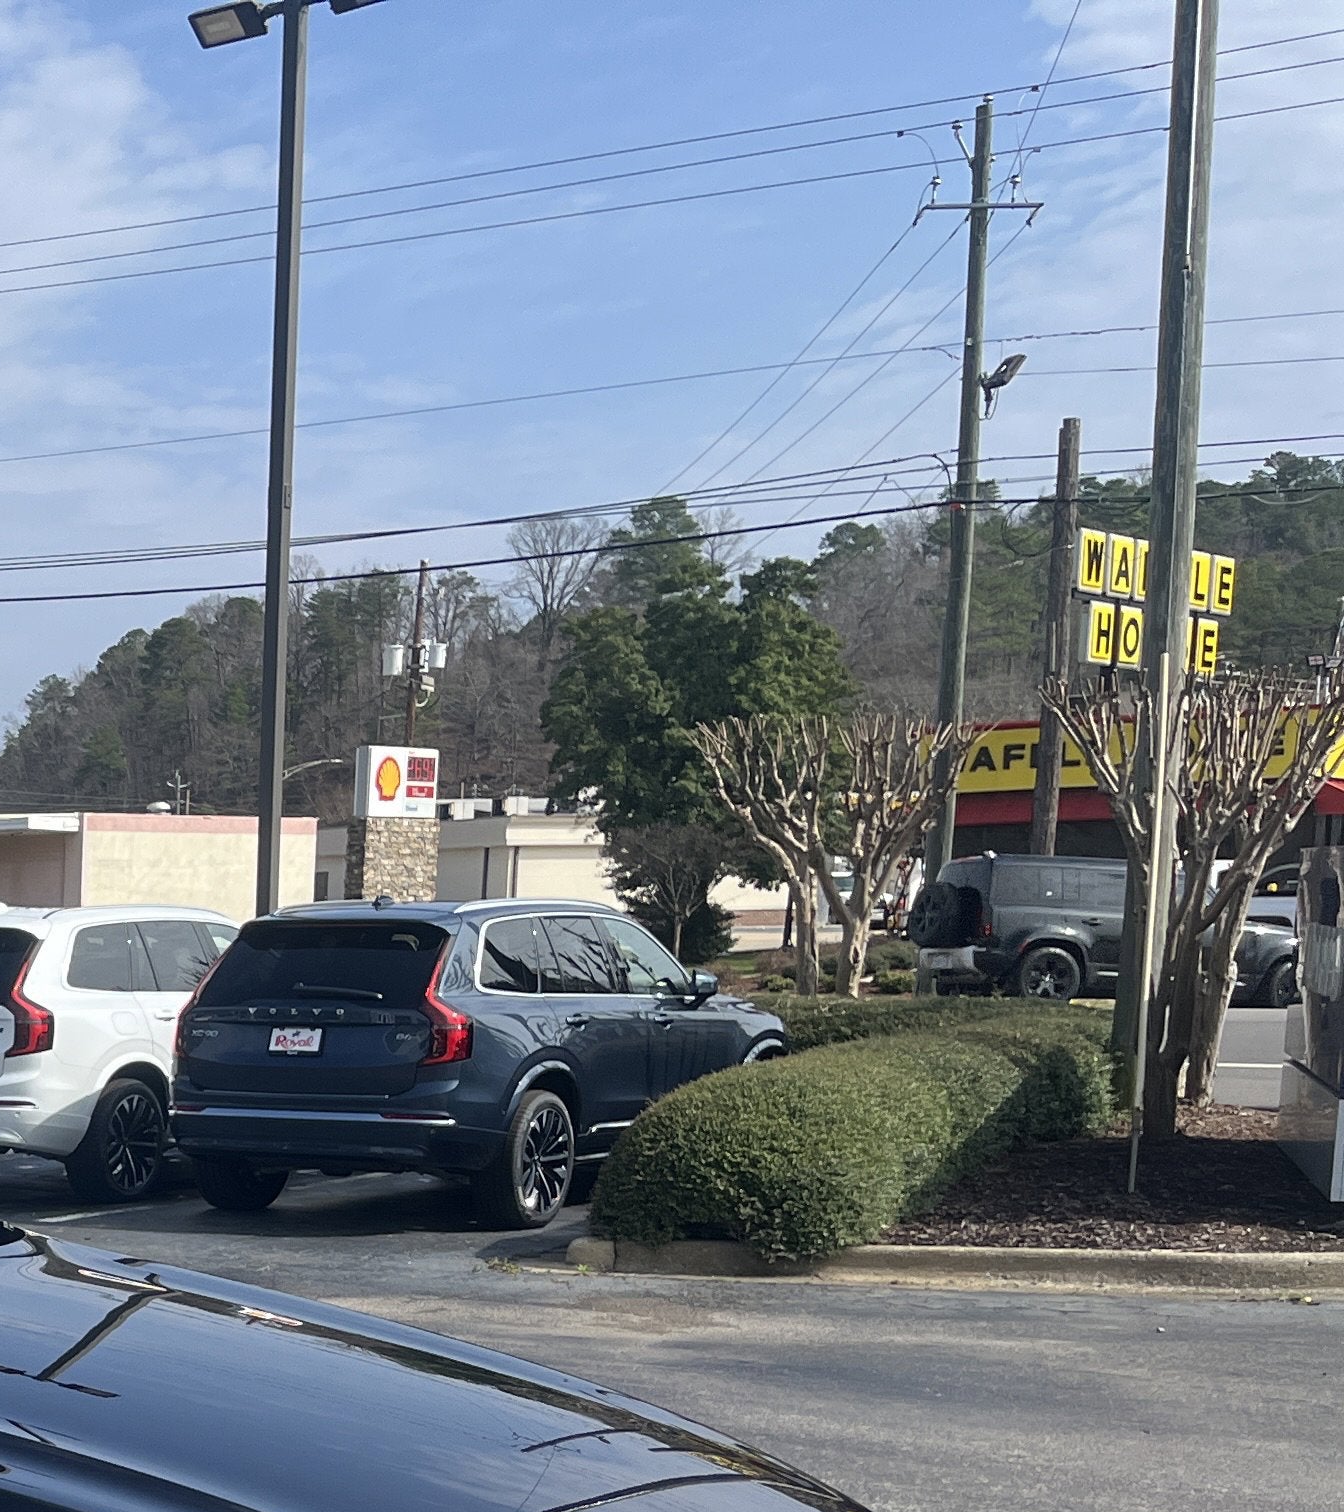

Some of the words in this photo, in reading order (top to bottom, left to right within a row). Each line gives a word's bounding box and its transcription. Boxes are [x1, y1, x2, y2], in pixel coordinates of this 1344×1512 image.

[1087, 539, 1232, 605] WALE
[1096, 611, 1215, 668] HOE
[248, 1008, 345, 1016] VOLVO
[274, 1034, 314, 1048] Royal
